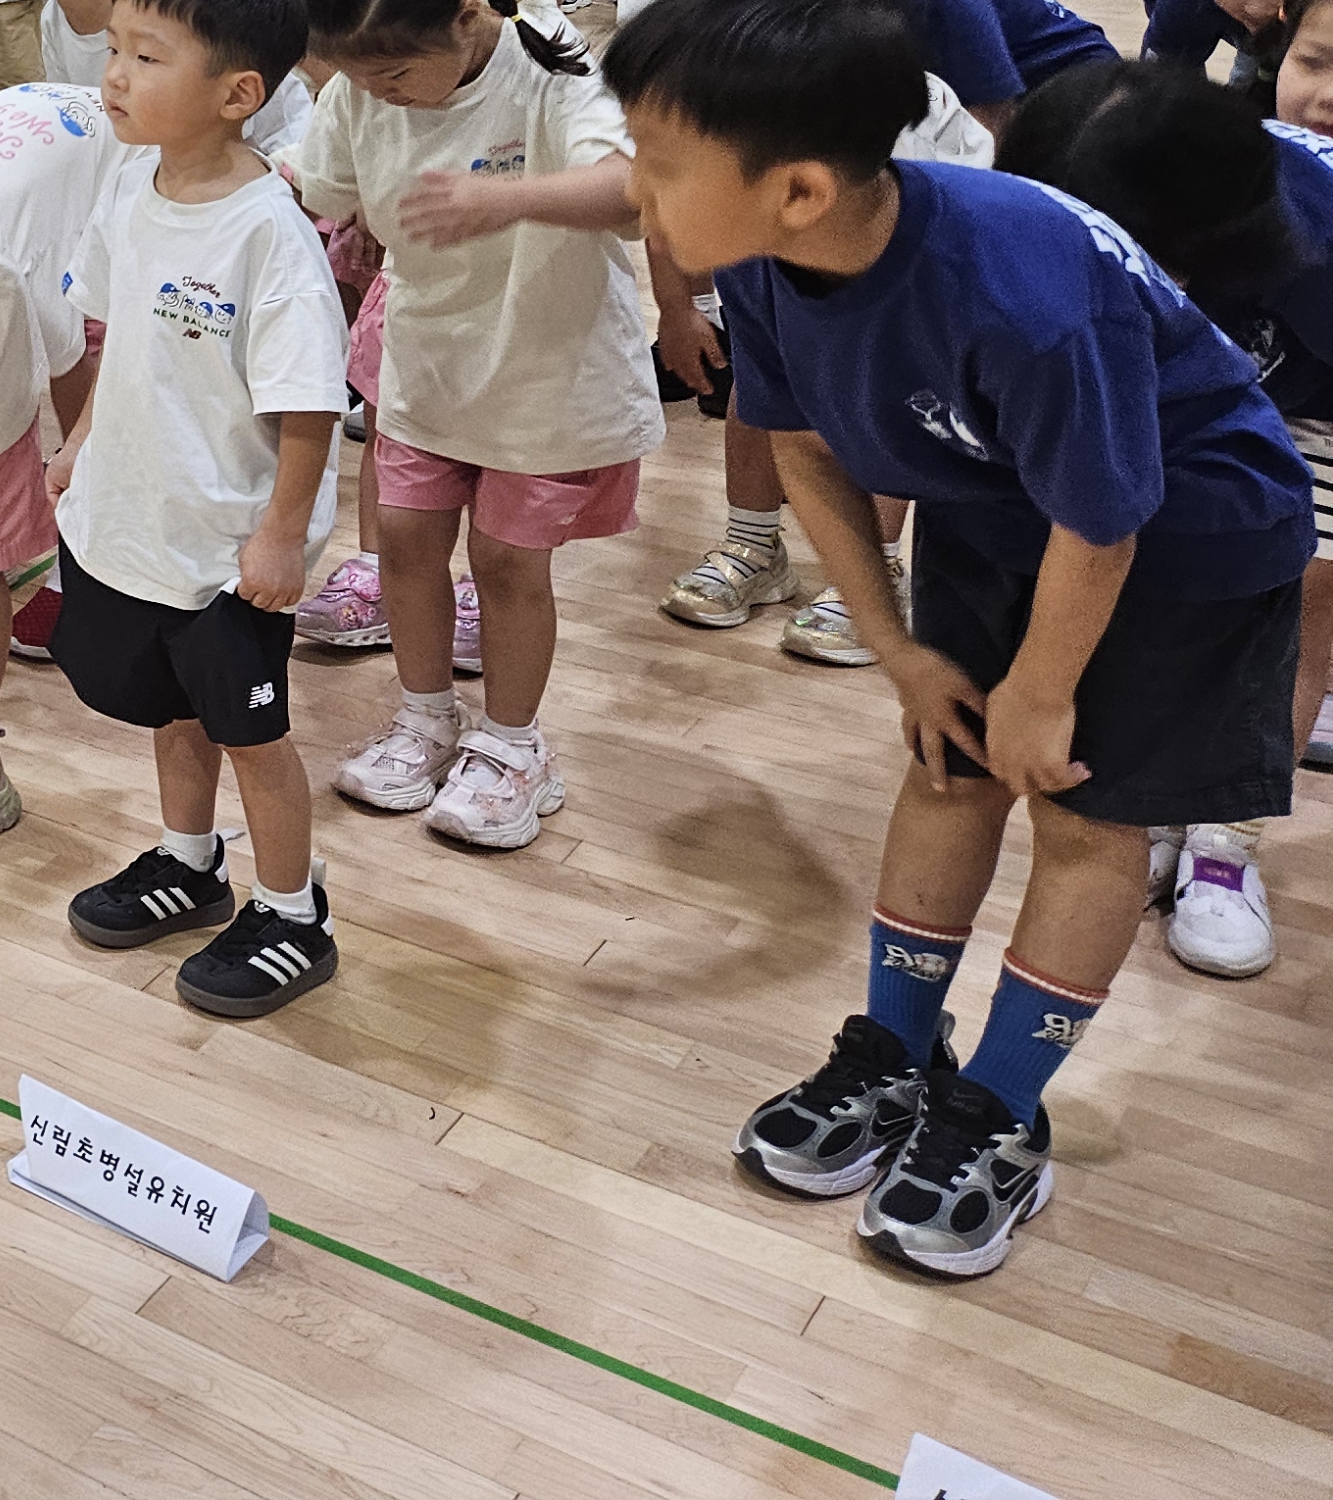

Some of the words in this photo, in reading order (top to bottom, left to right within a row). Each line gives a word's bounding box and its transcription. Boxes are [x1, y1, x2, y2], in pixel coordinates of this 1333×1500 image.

[182, 275, 221, 299] Together
[153, 307, 178, 320] NEW
[182, 315, 232, 338] BALANCE
[30, 1114, 218, 1235] 신림초병설유치원
